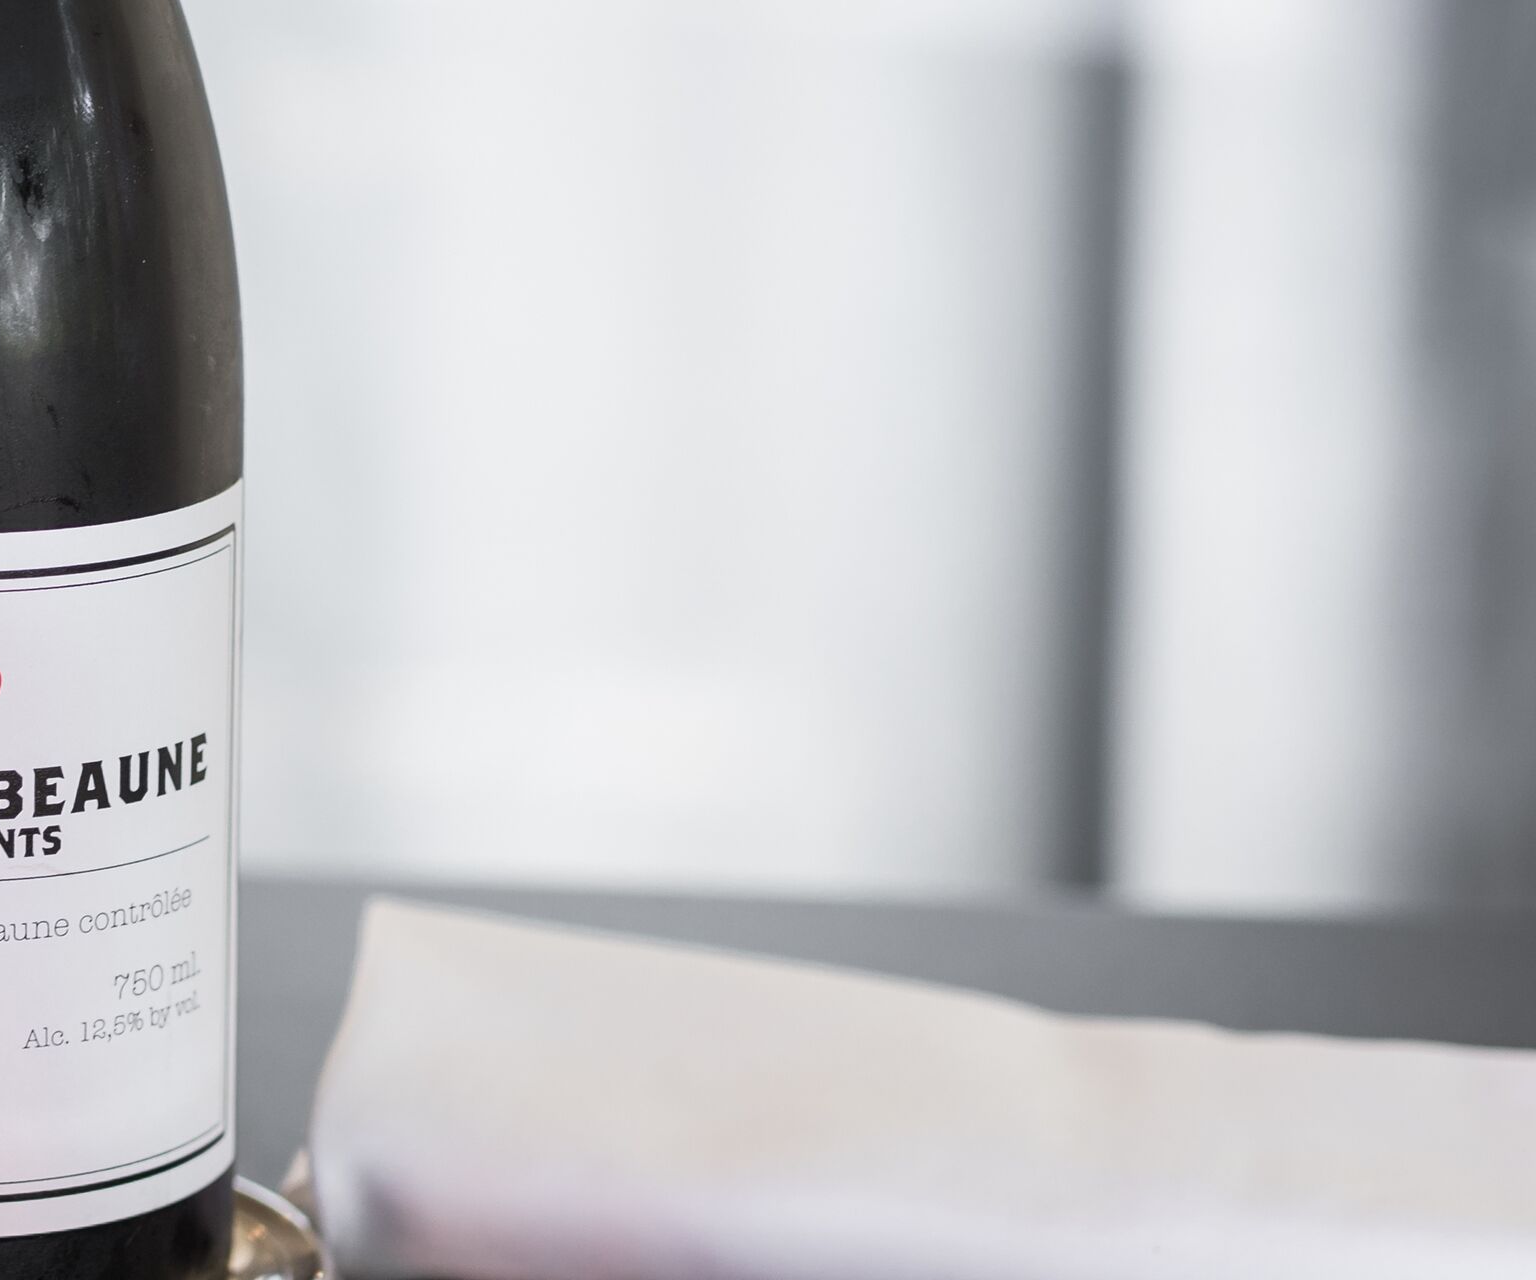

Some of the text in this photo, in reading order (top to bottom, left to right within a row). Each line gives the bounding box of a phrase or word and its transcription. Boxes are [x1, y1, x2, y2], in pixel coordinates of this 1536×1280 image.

[79, 887, 192, 934] contrôlée
[114, 964, 164, 1000] 750
[22, 1026, 70, 1050] Alc.
[80, 1010, 144, 1043] 12,5%
[149, 1005, 172, 1029] by
